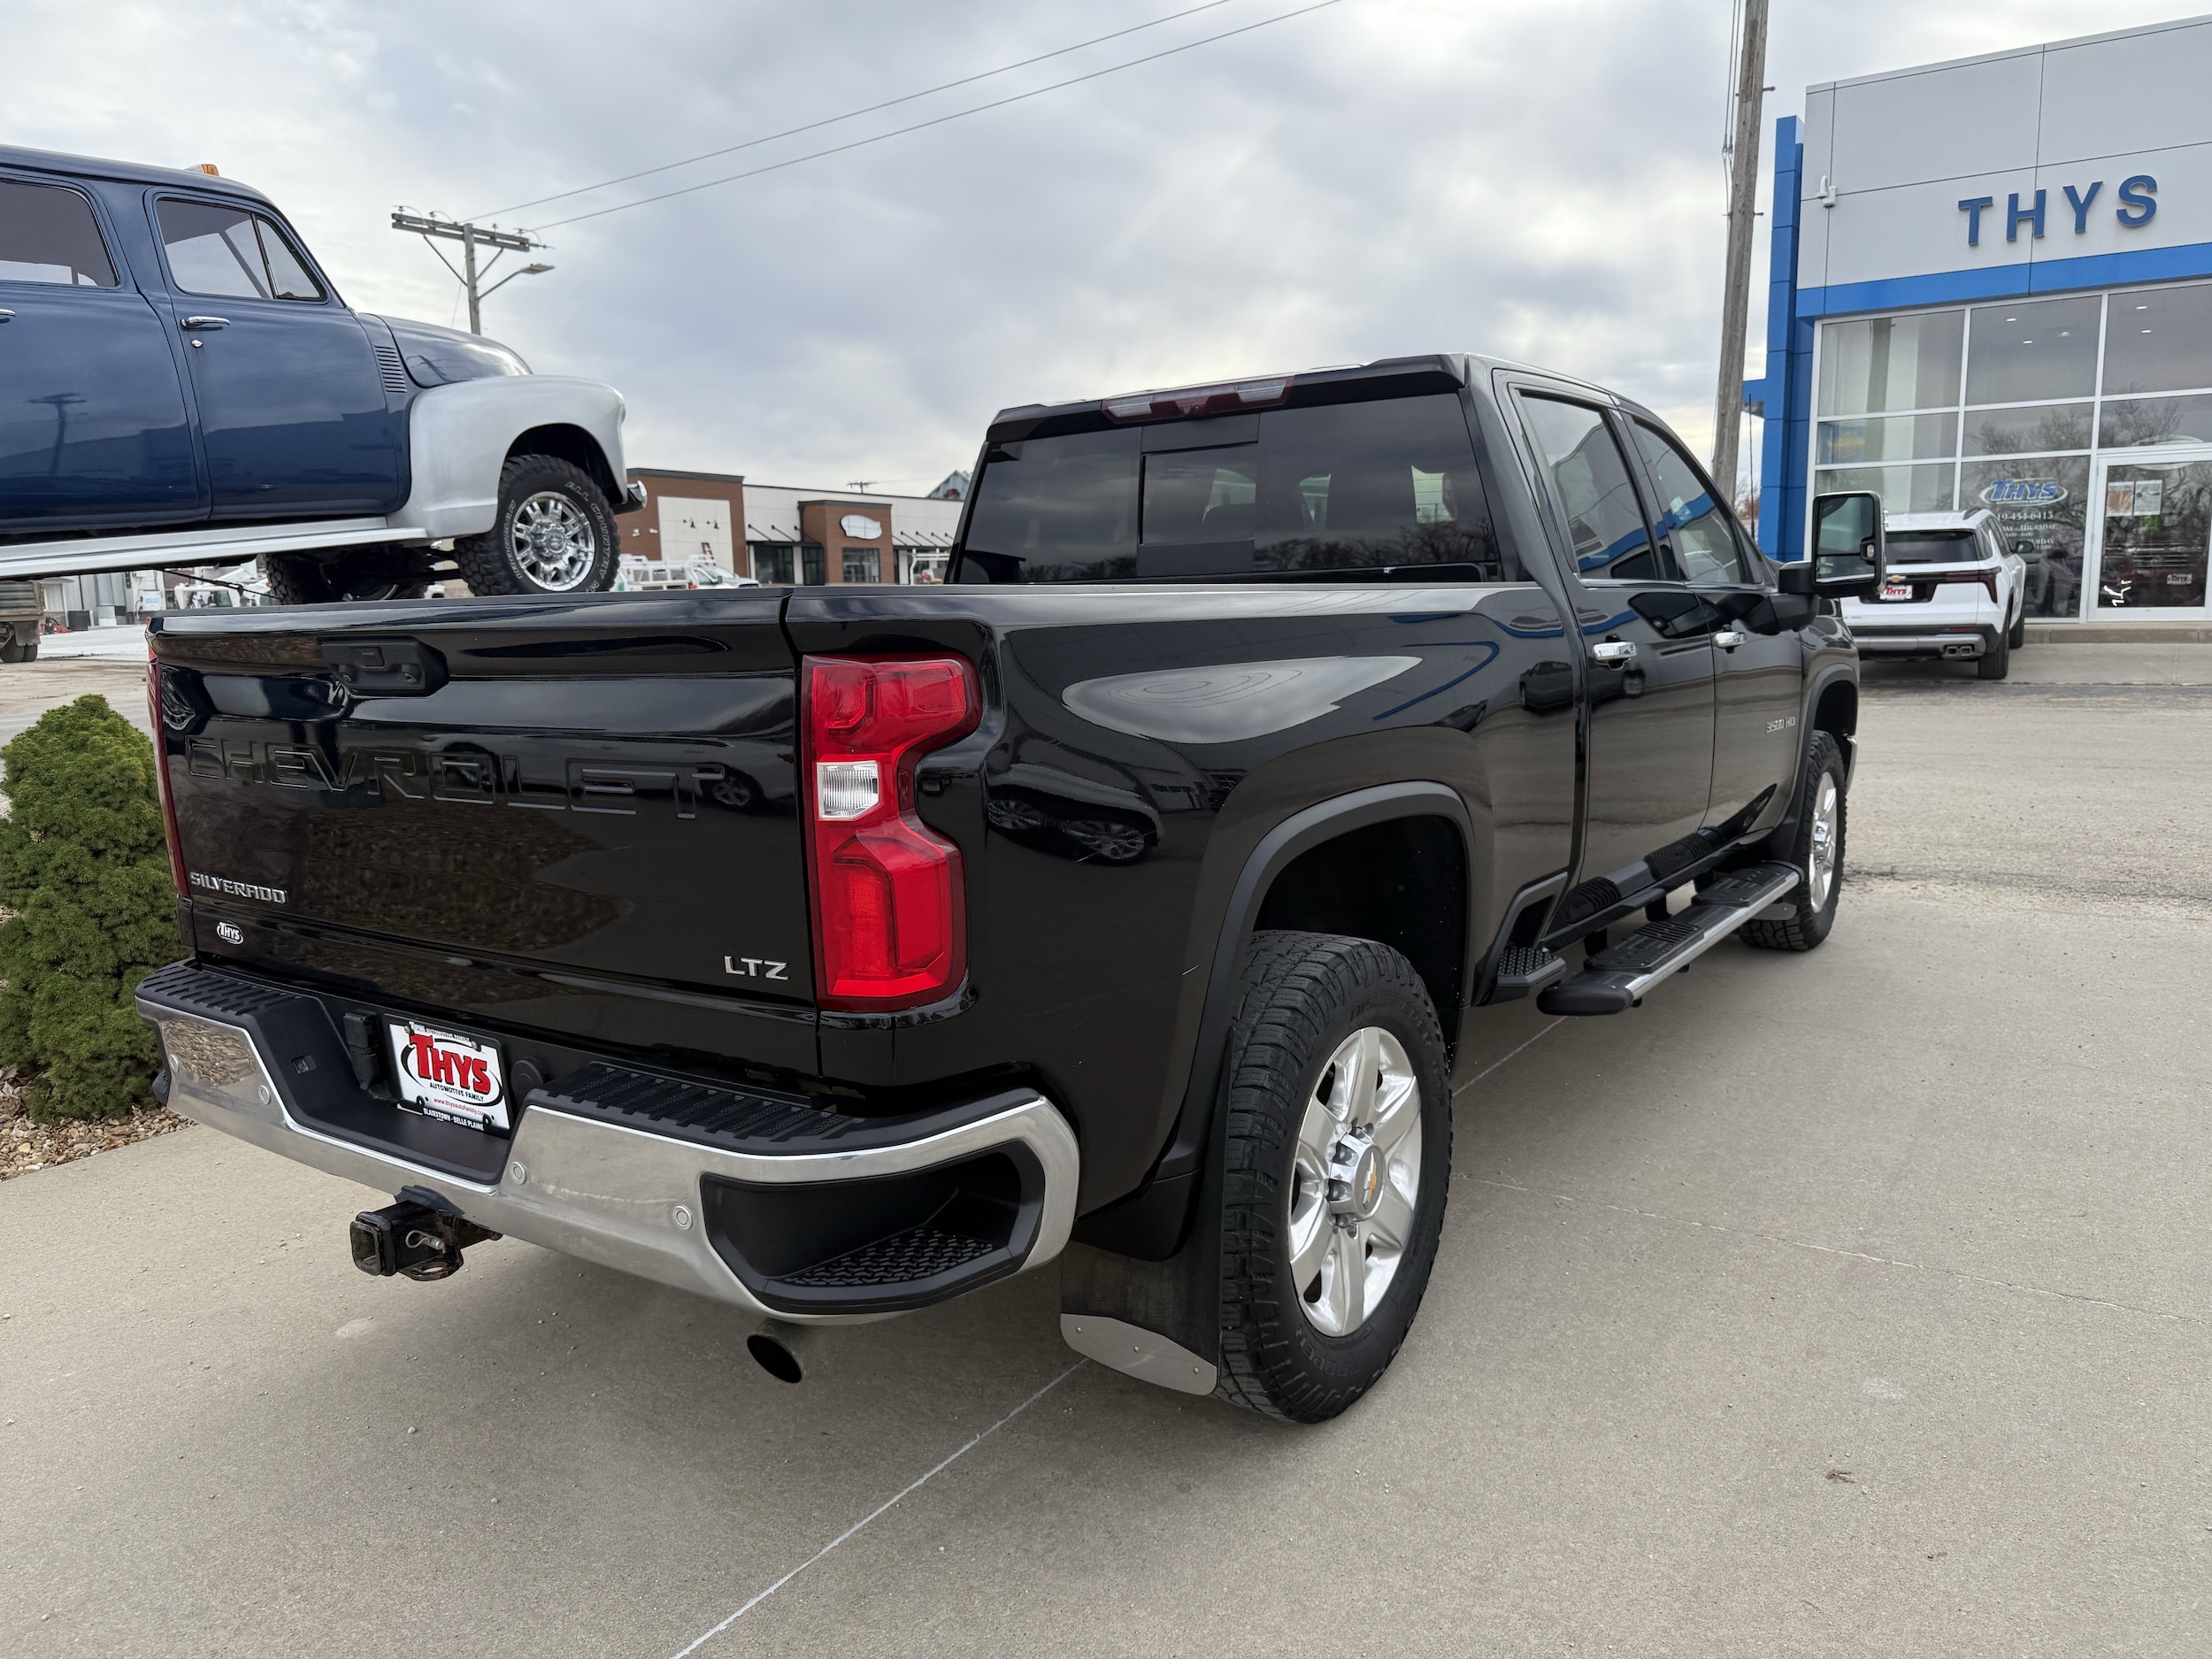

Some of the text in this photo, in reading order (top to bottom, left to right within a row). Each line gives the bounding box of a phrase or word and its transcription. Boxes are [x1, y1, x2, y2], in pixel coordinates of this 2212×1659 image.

[1958, 174, 2158, 247] THYS
[1991, 480, 2057, 501] THYS
[565, 480, 589, 503] ALL
[590, 503, 612, 580] COUNTRY
[184, 734, 726, 820] CHEVROLET
[190, 871, 288, 903] SILVERADO
[219, 922, 240, 941] THYS
[725, 956, 789, 980] LTZ
[409, 1033, 491, 1094] THYS
[429, 1082, 484, 1102] AUTOMOTIVE FAMILY
[422, 1107, 451, 1121] BLAIRSTOWN
[453, 1116, 467, 1126] BELLE
[467, 1119, 485, 1132] PLAINE
